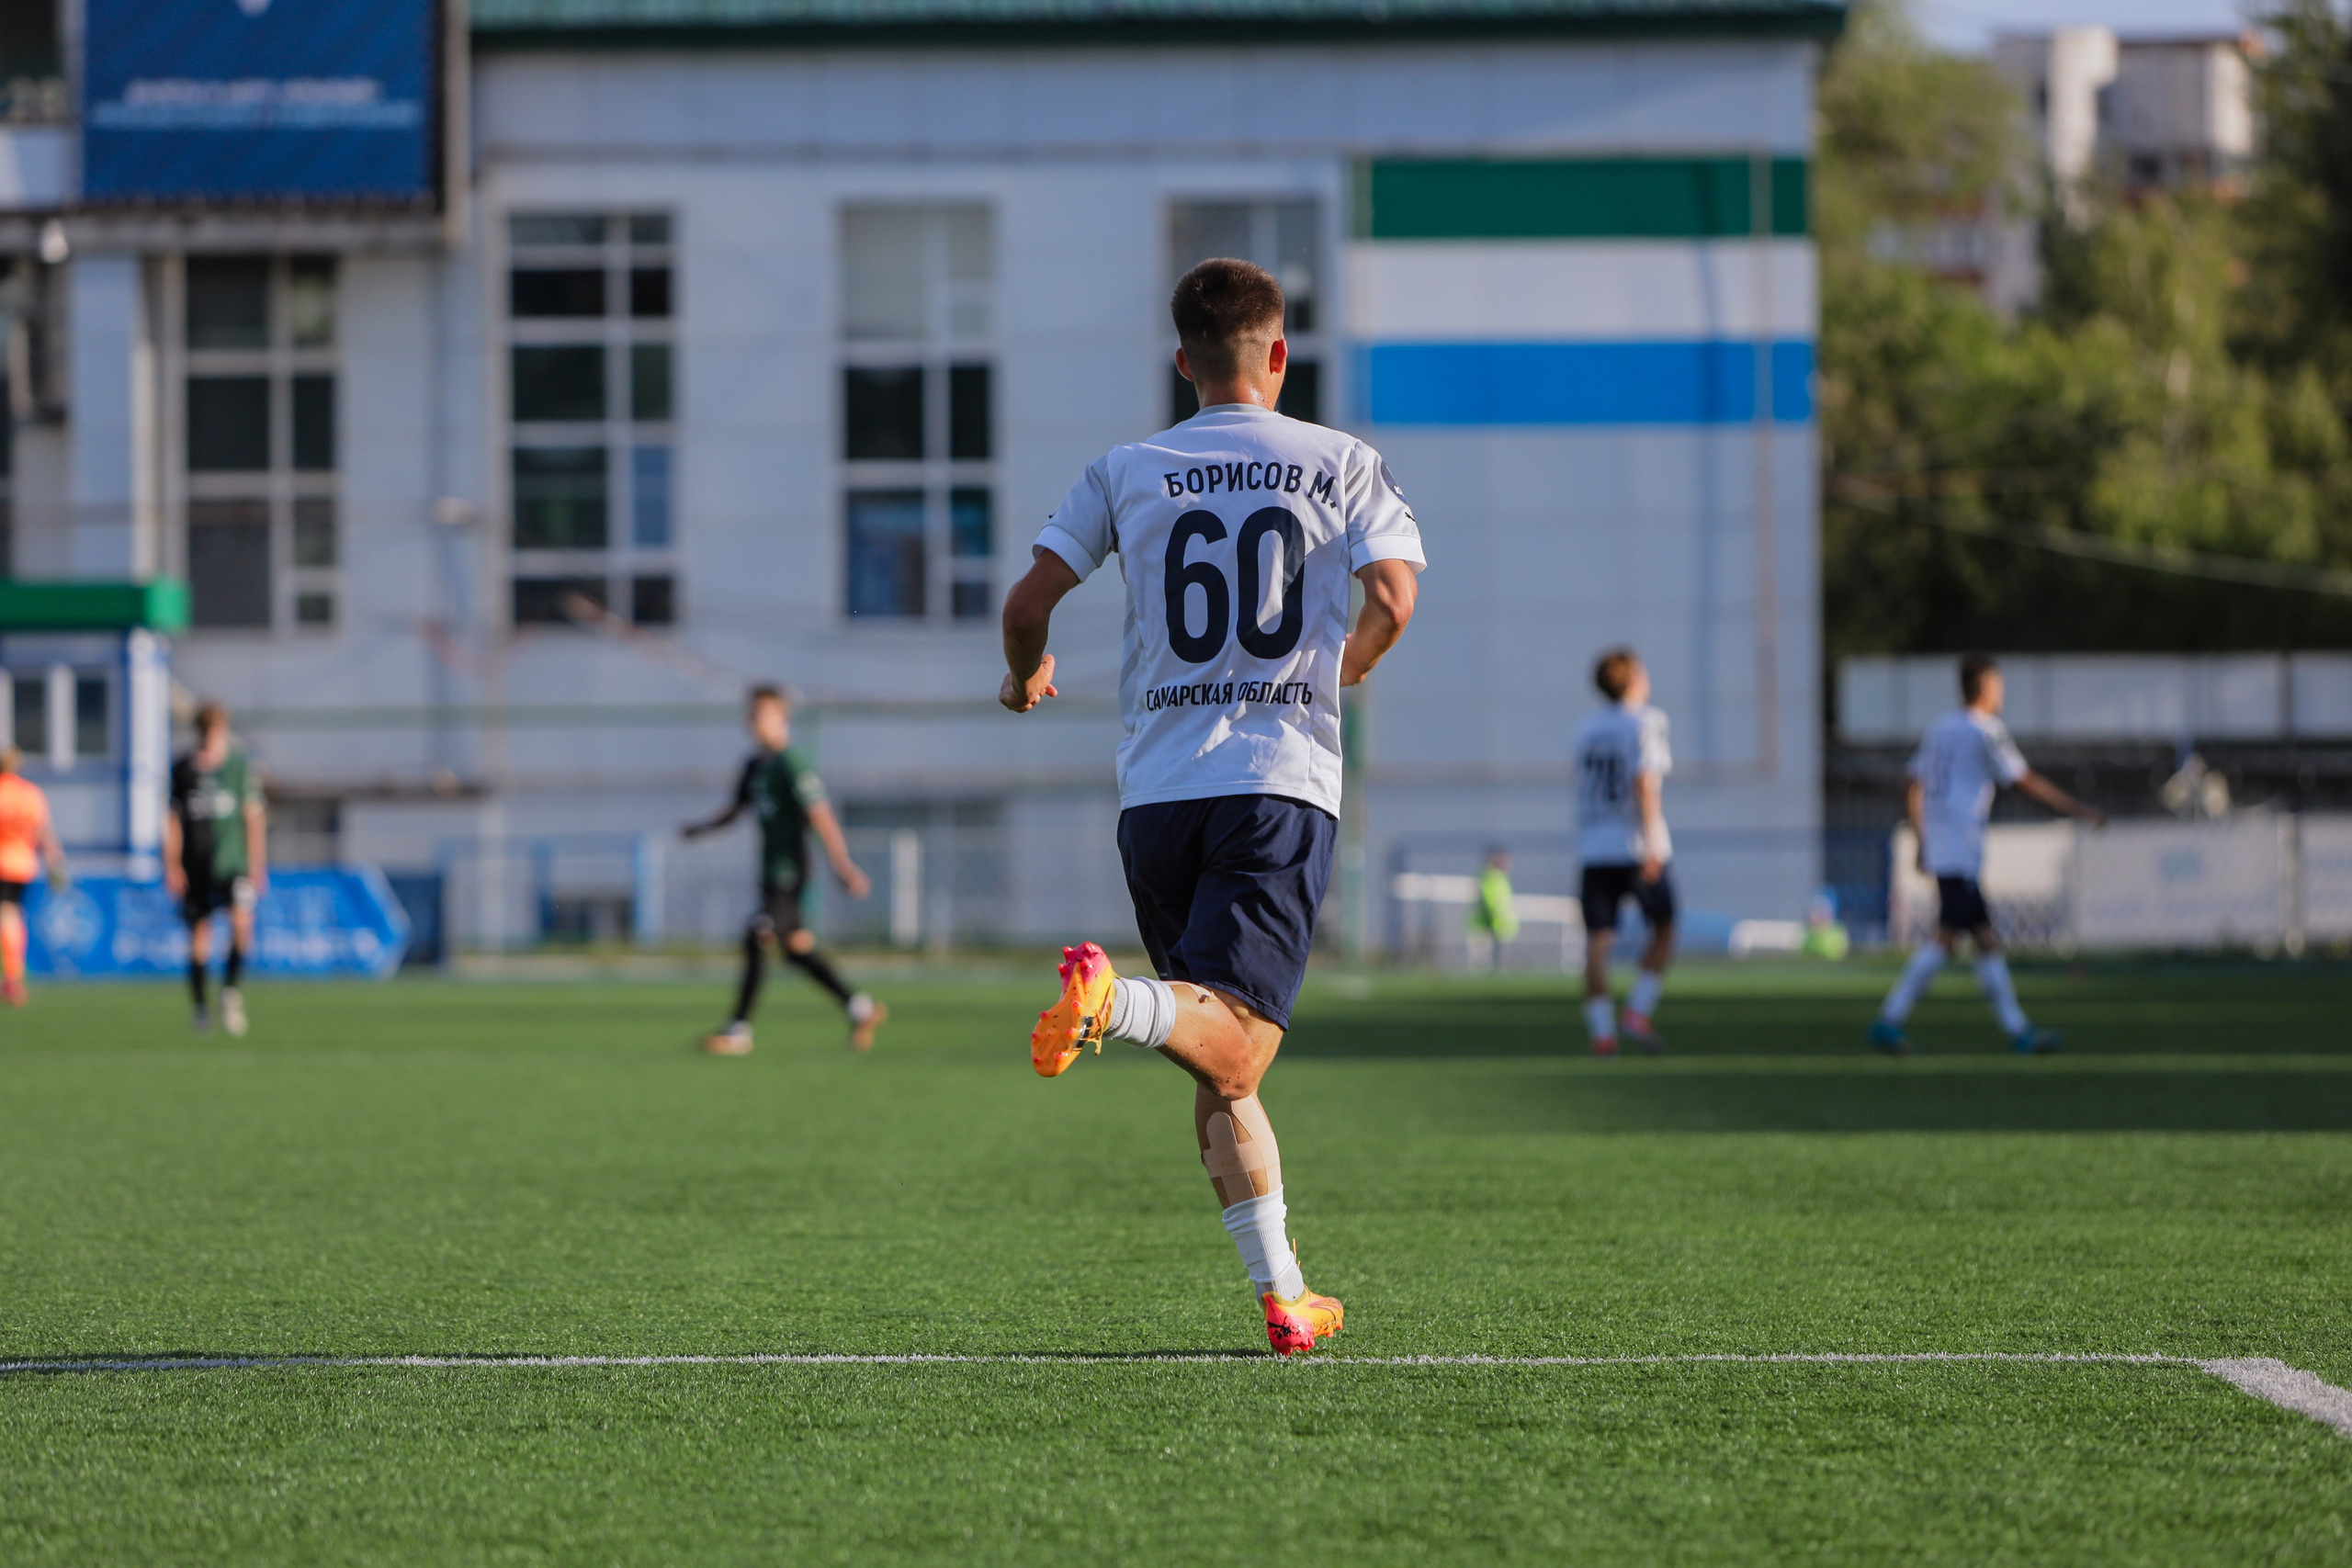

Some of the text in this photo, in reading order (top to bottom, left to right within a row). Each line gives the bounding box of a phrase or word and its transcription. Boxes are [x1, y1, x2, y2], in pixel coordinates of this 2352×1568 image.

[1164, 462, 1337, 509] БОРИСОВ М.
[1164, 506, 1306, 663] 60
